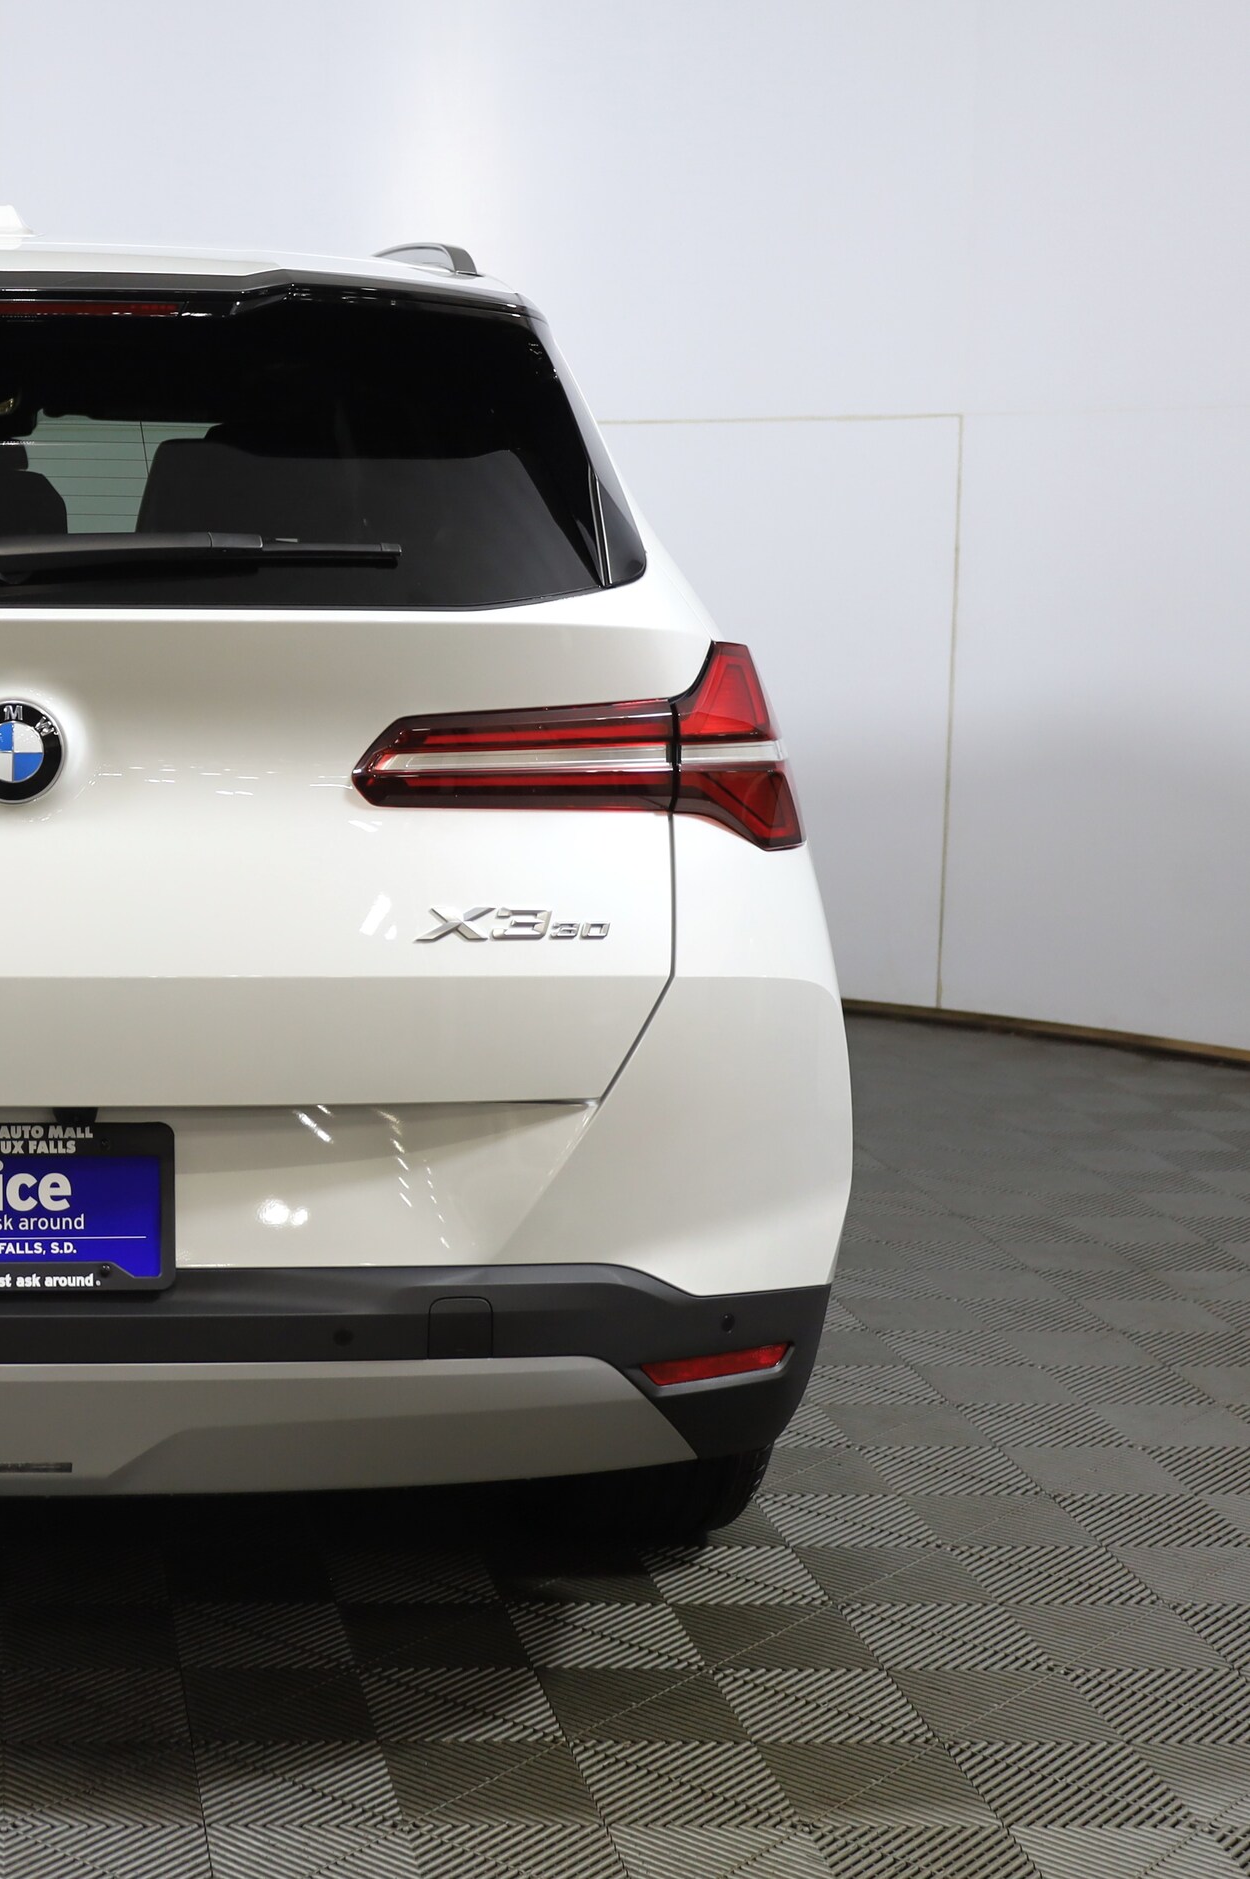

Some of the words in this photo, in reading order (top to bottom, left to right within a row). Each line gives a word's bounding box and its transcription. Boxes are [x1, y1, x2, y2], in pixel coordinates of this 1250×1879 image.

[48, 1125, 94, 1139] MALL
[28, 1140, 77, 1154] FALLS
[18, 1213, 85, 1231] around
[50, 1242, 77, 1254] S.D.
[15, 1273, 41, 1288] ask
